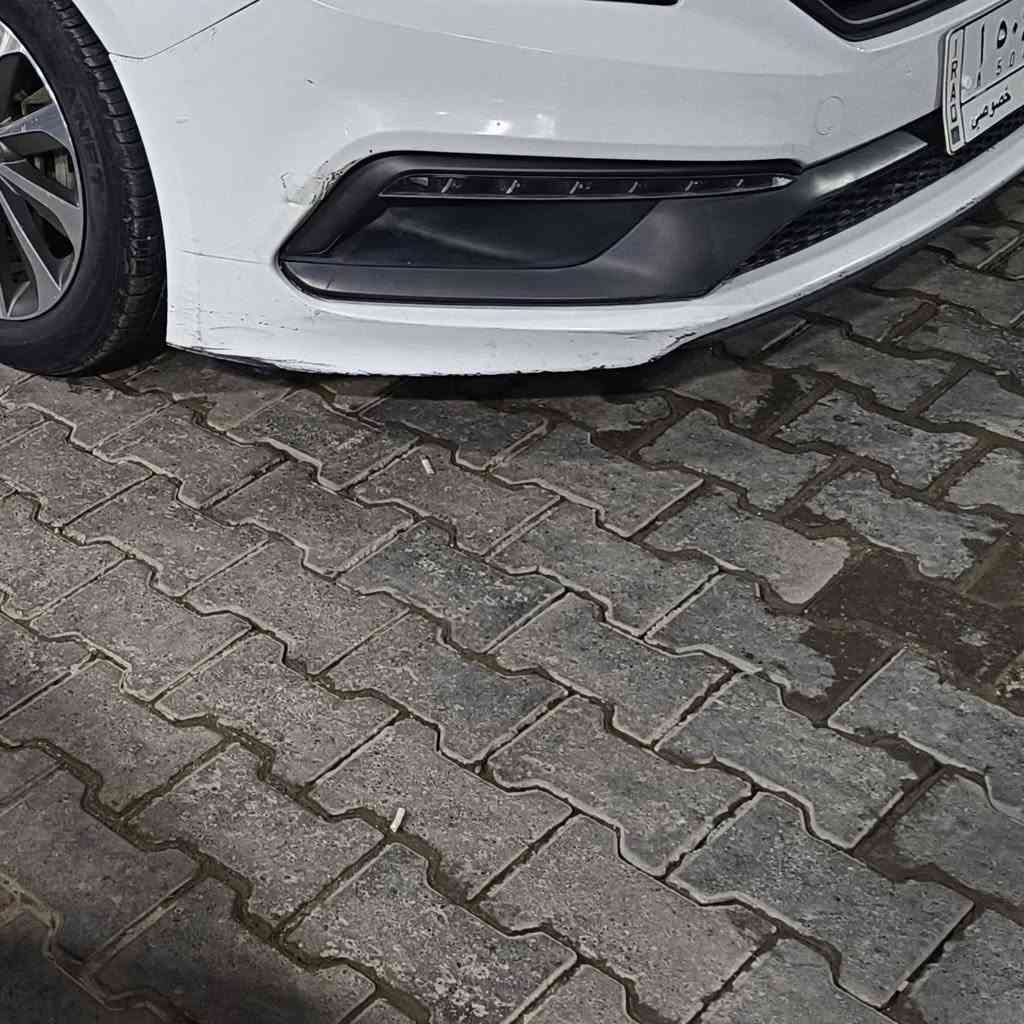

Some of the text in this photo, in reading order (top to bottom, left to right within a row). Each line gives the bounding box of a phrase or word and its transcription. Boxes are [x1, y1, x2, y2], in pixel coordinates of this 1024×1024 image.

[996, 20, 1024, 50] ٥٠
[996, 50, 1024, 76] 50
[971, 88, 1012, 130] خصوصي
